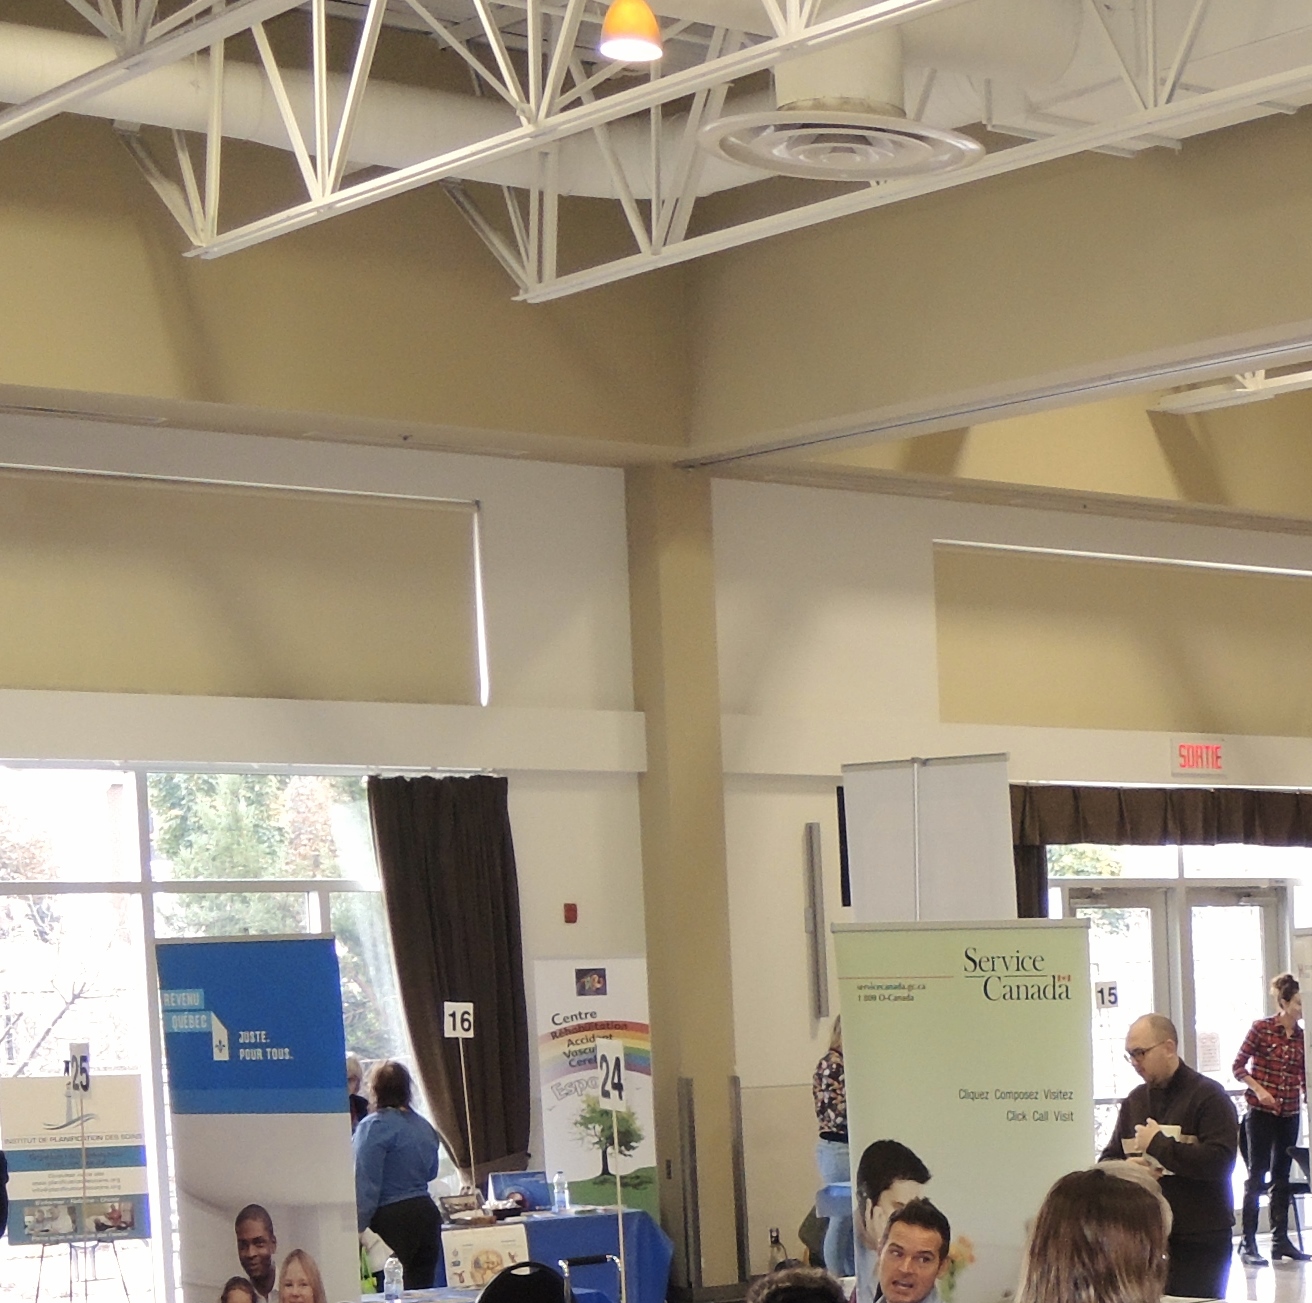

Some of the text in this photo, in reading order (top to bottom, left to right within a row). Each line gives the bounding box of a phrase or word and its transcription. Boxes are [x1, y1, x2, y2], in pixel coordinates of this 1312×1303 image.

[1179, 744, 1222, 769] SORTIE
[964, 947, 1045, 973] Service
[983, 974, 1072, 1001] Canada
[1097, 986, 1118, 1005] 15
[163, 992, 199, 1007] REVENU
[171, 1011, 208, 1031] QUÉBEC
[448, 1010, 472, 1032] 16
[551, 1009, 598, 1026] Centre
[239, 1030, 271, 1043] JUSTE.
[550, 1022, 629, 1041] Réhabilitation
[239, 1047, 294, 1061] POUR TOUS.
[563, 1044, 598, 1060] Vascu
[71, 1055, 91, 1092] 25
[599, 1053, 624, 1101] 24
[959, 1089, 1074, 1101] Cliquez Composez Visitez
[1006, 1110, 1074, 1122] Click Call Visit
